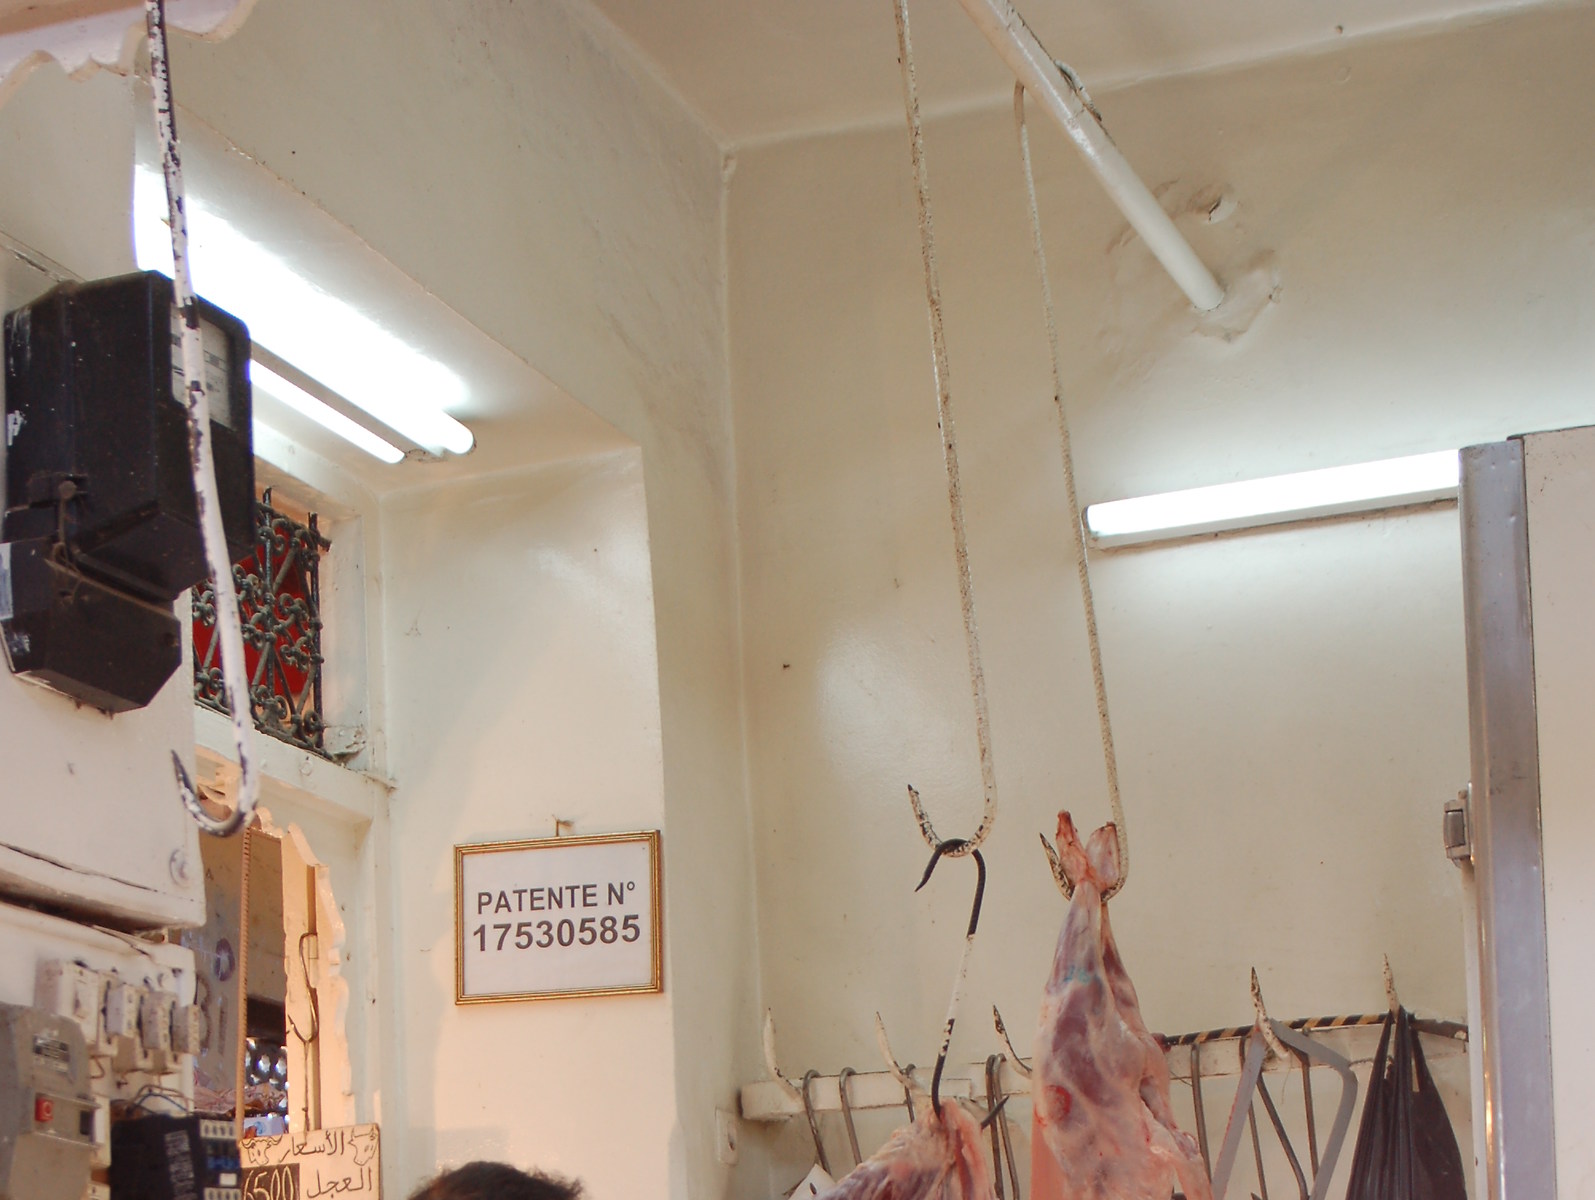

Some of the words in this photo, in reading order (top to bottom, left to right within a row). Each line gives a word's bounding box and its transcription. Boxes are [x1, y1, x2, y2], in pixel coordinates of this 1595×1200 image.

[477, 884, 598, 915] PATENTE
[607, 881, 636, 906] N°
[473, 914, 640, 952] 17530585
[279, 1130, 344, 1163] الأسعار
[307, 1166, 372, 1199] العجل
